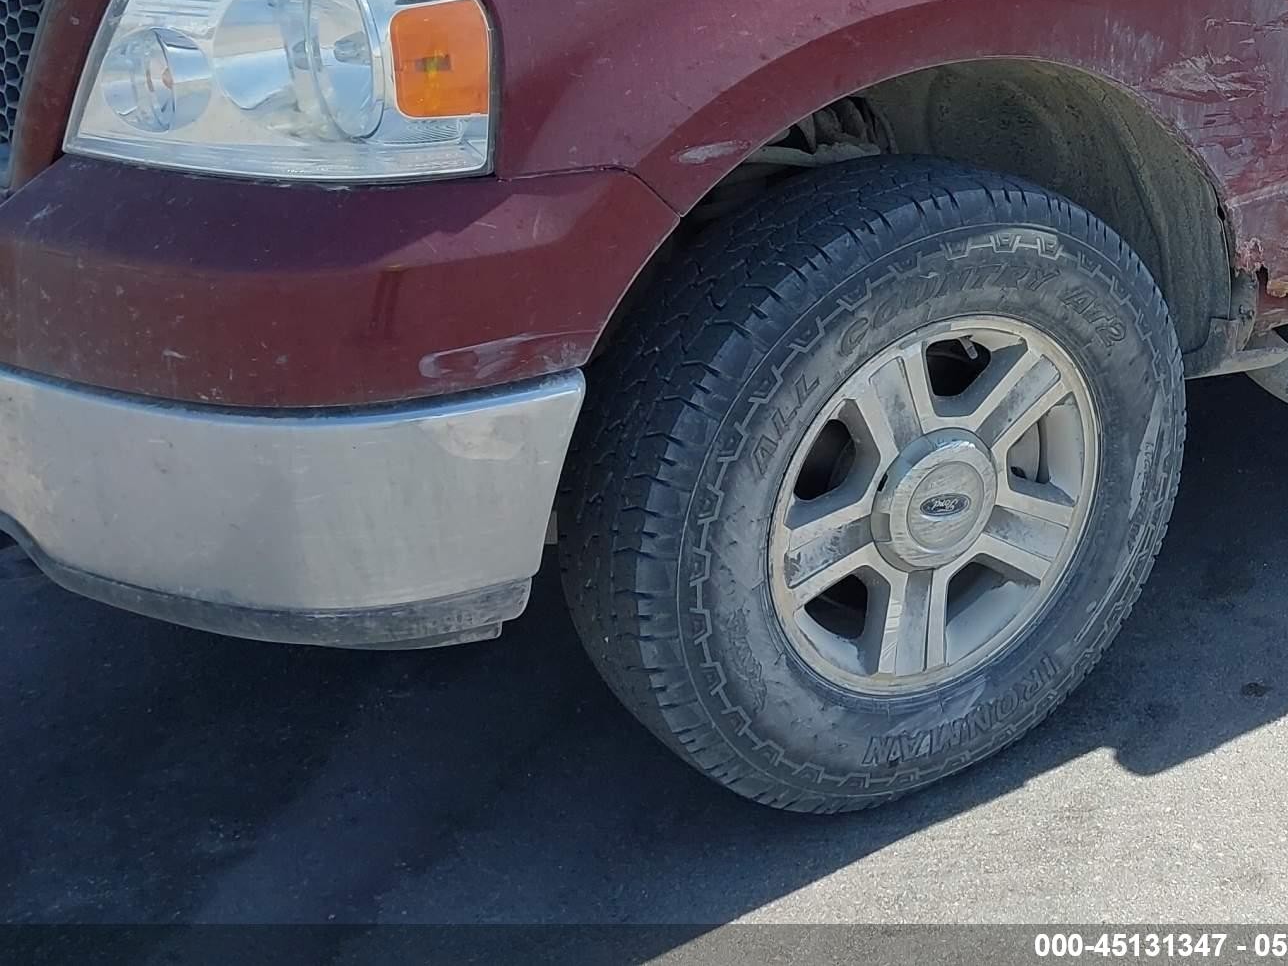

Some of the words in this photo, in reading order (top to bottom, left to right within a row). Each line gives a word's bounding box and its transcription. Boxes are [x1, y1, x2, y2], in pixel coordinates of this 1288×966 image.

[750, 372, 820, 477] ALL
[837, 263, 1060, 358] COUNTRY
[861, 655, 1061, 767] IRONMAN
